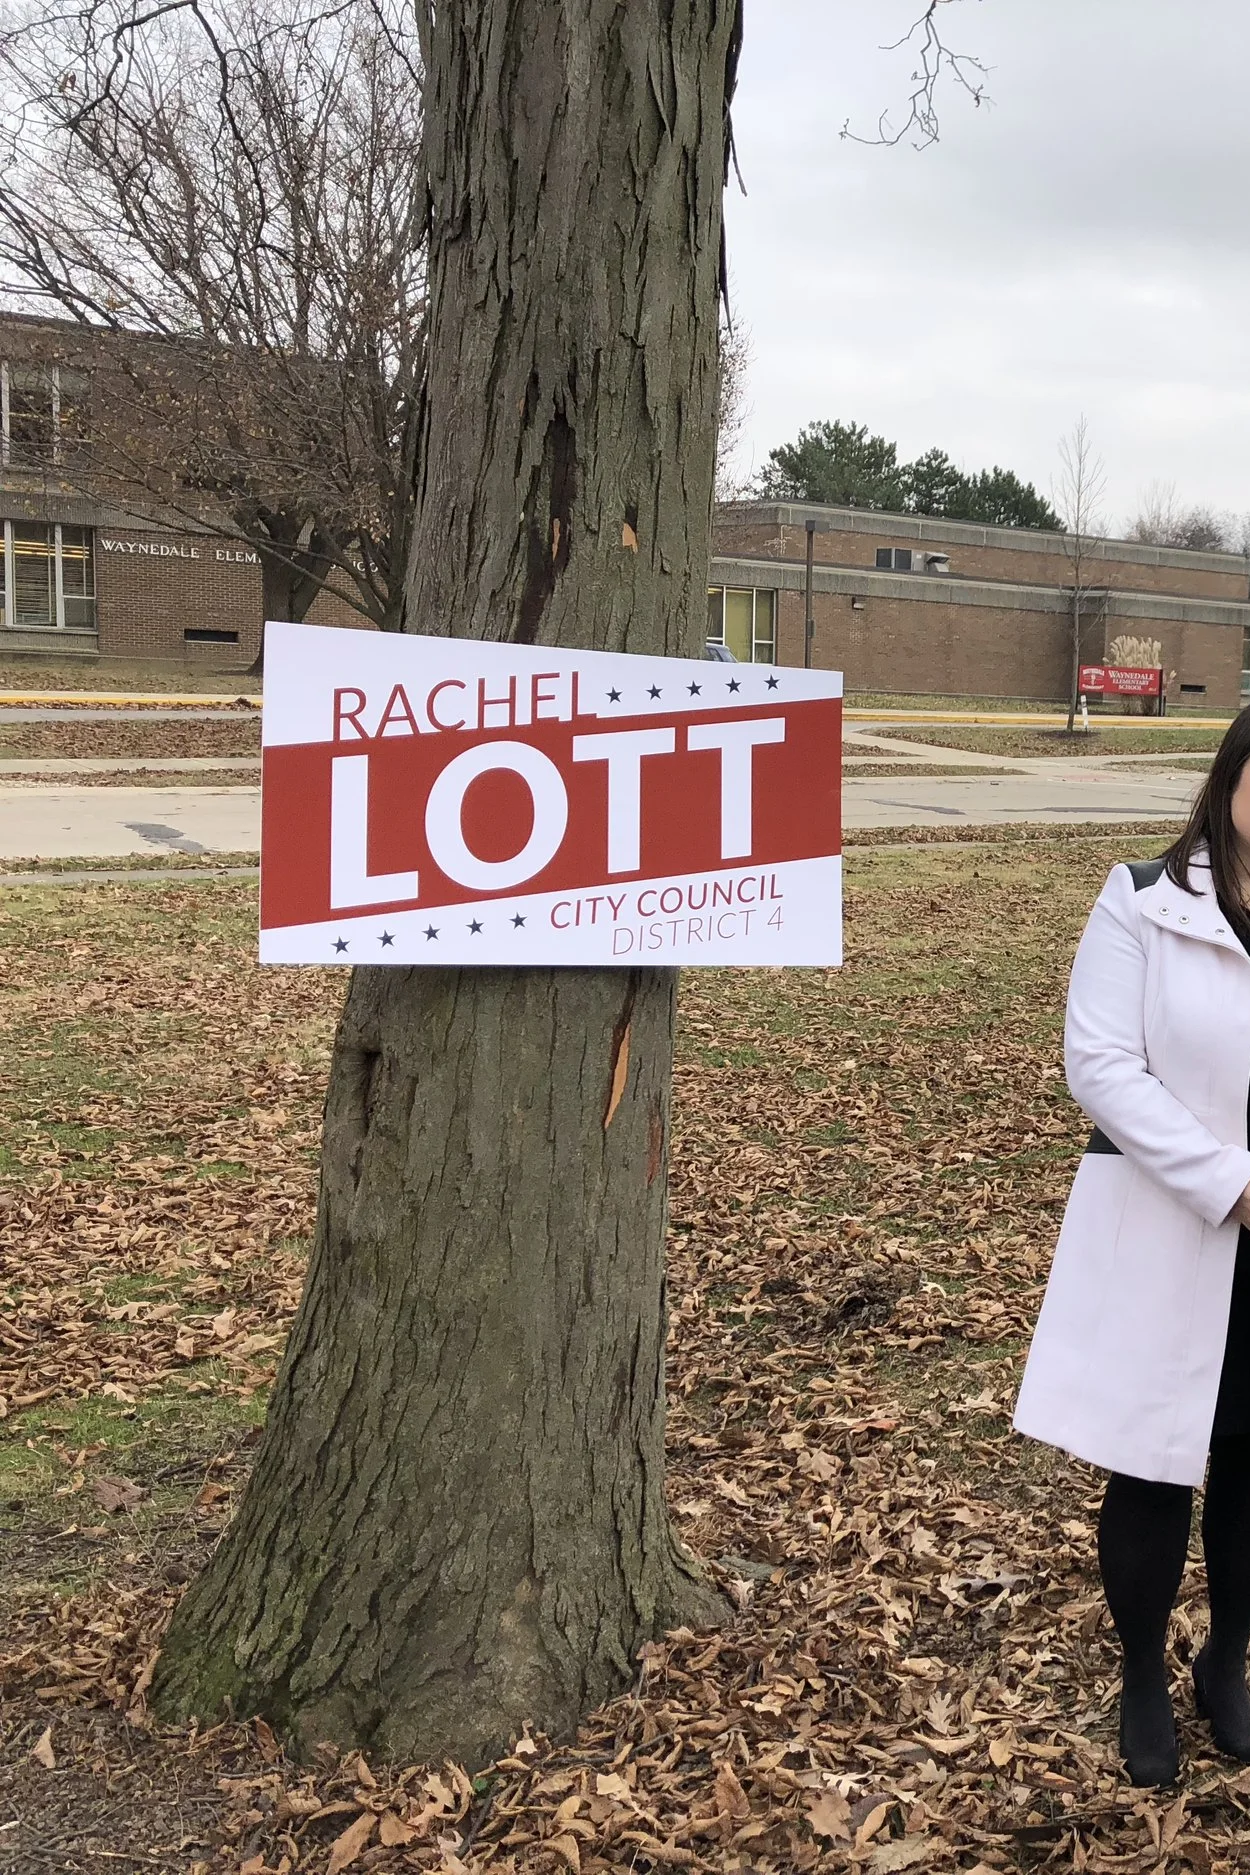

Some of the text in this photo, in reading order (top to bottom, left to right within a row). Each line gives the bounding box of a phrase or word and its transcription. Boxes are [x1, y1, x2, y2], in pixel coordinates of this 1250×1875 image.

[101, 539, 262, 563] WAYNEDALE ELEM
[1108, 670, 1155, 680] WAYNEDALE
[332, 670, 598, 742] RACHEL
[330, 716, 786, 910] LOTT
[550, 873, 784, 930] CITY COUNCIL
[612, 905, 785, 956] DISTRICT 4
